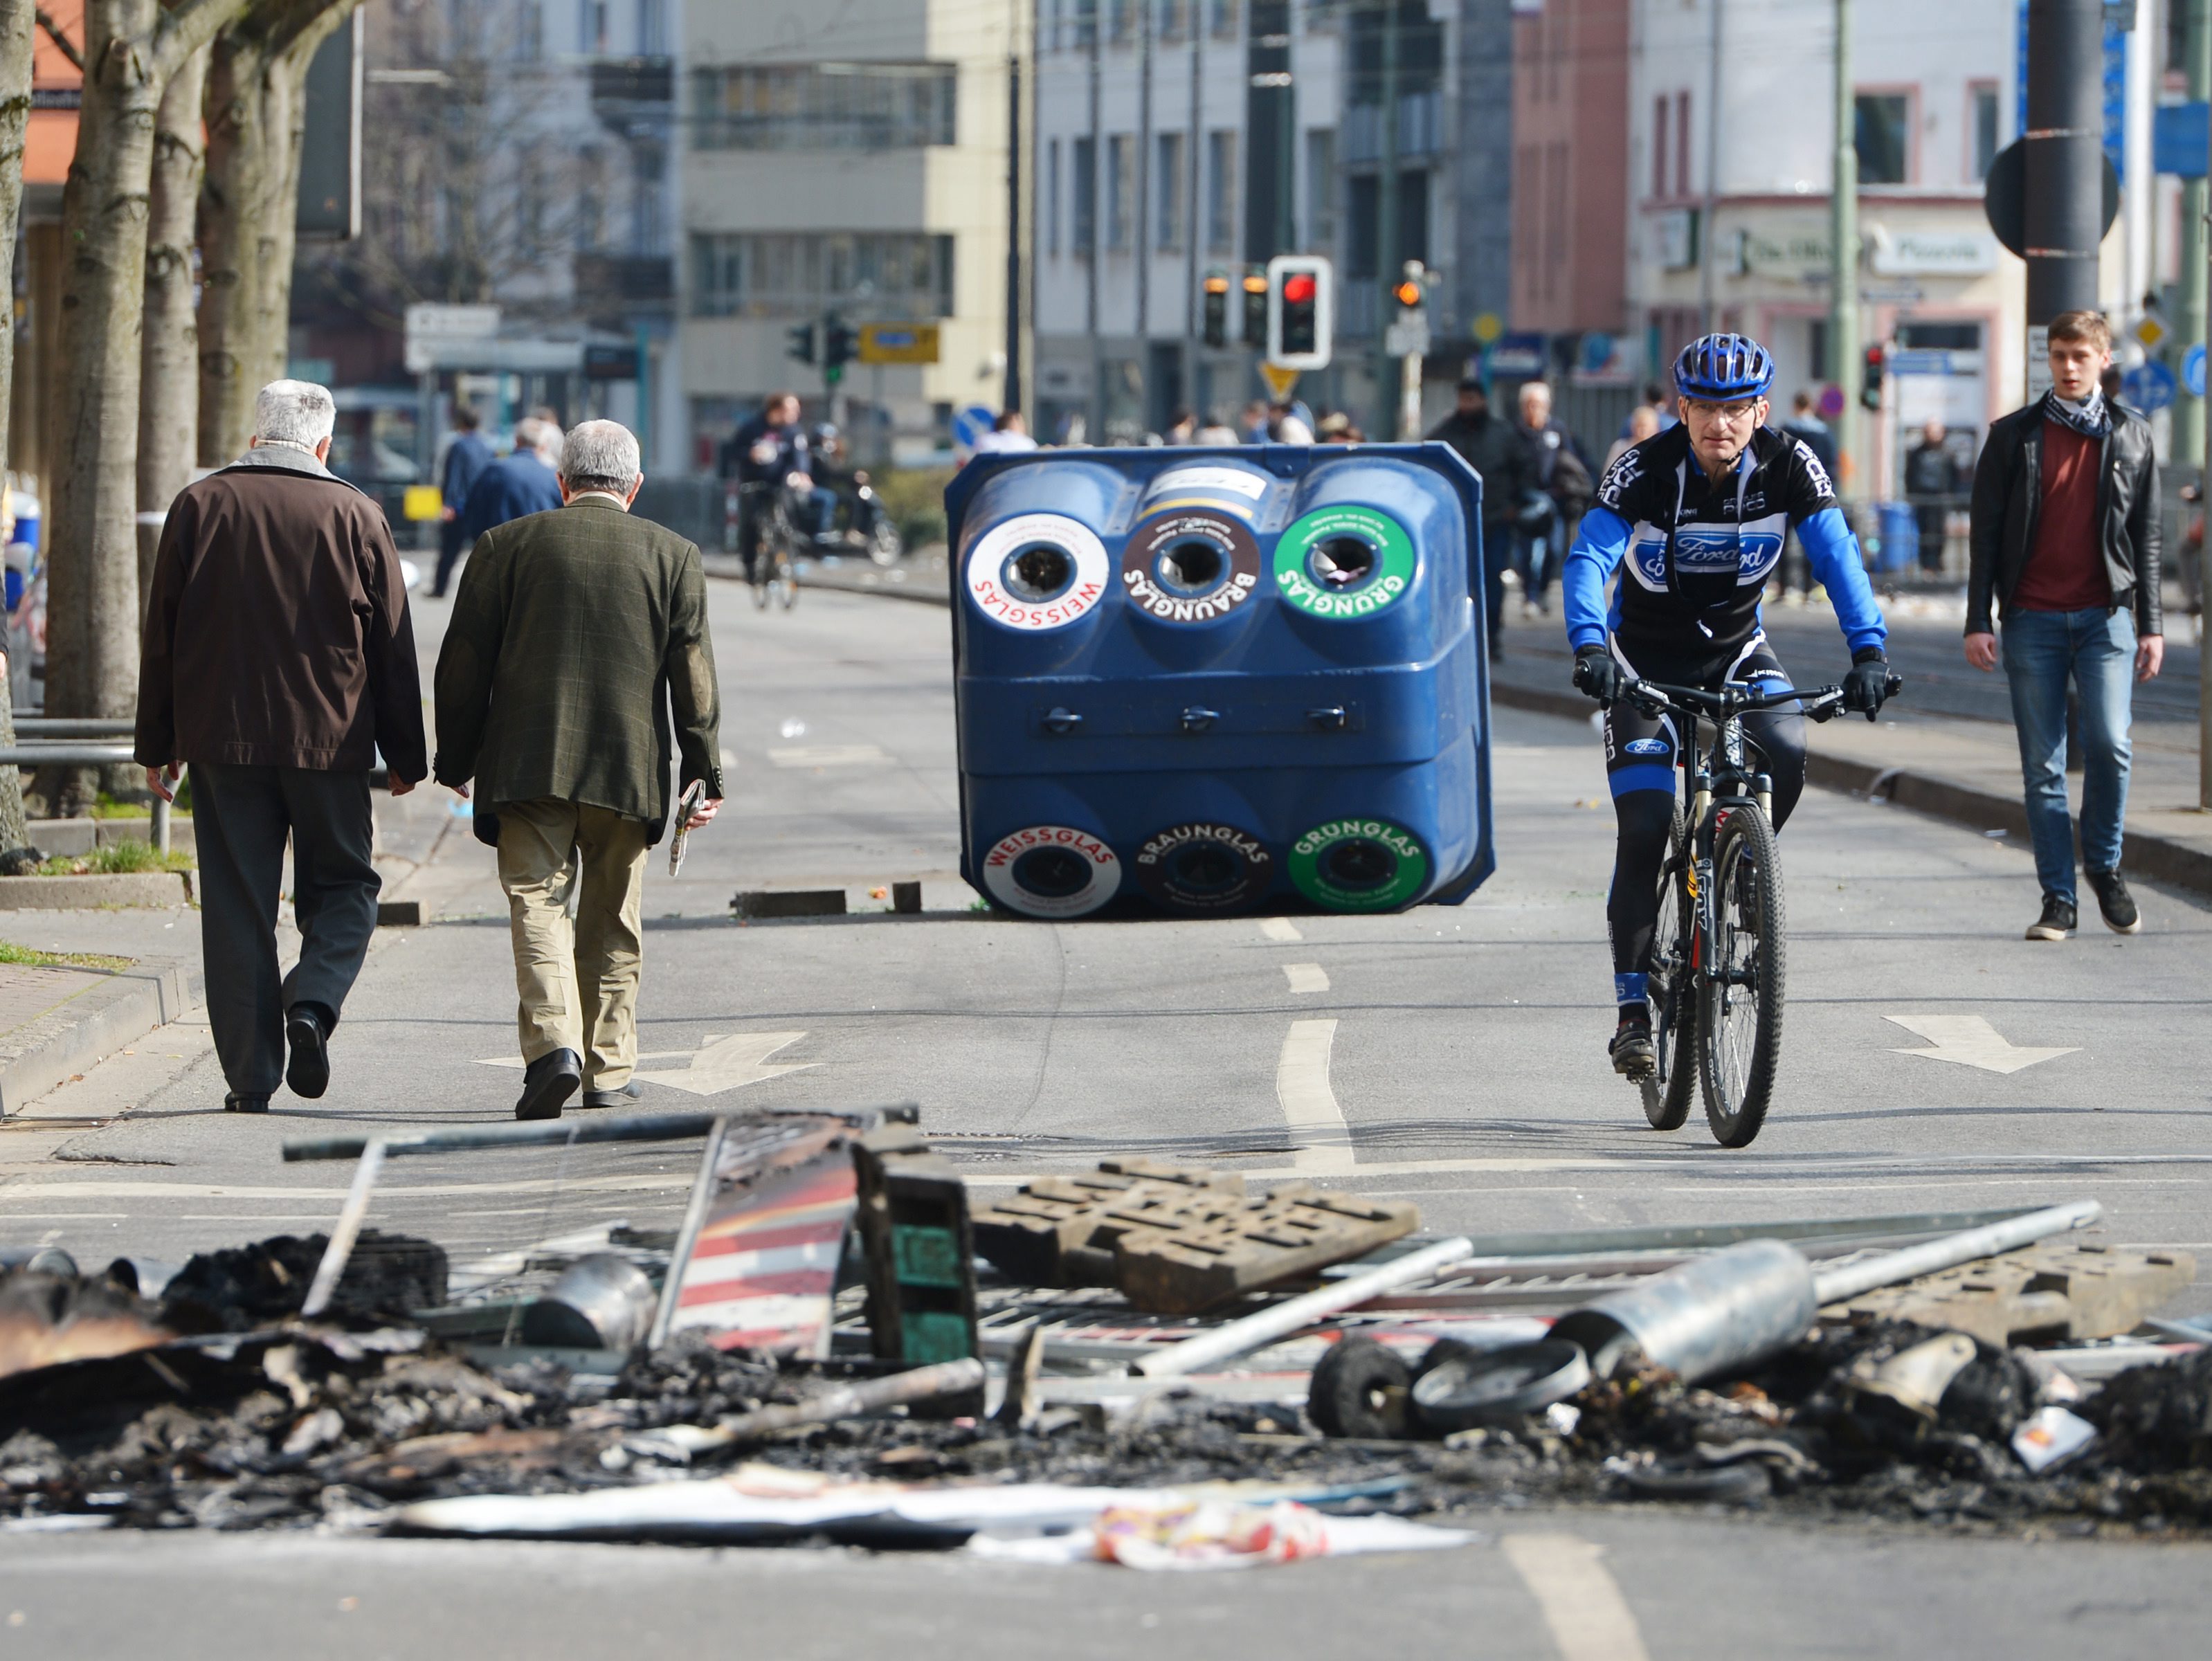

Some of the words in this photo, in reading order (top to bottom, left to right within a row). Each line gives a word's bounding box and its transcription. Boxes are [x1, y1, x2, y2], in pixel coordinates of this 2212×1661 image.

[974, 581, 1102, 626] WEISSGLAS
[1123, 569, 1257, 621] BRAUNGLAS
[1278, 570, 1404, 615] GRÜNGLAS
[1634, 741, 1662, 752] Ford
[988, 827, 1114, 866] WEISSGLAS
[1137, 824, 1269, 864] BRAUNGLAS
[1696, 875, 1708, 932] FOX
